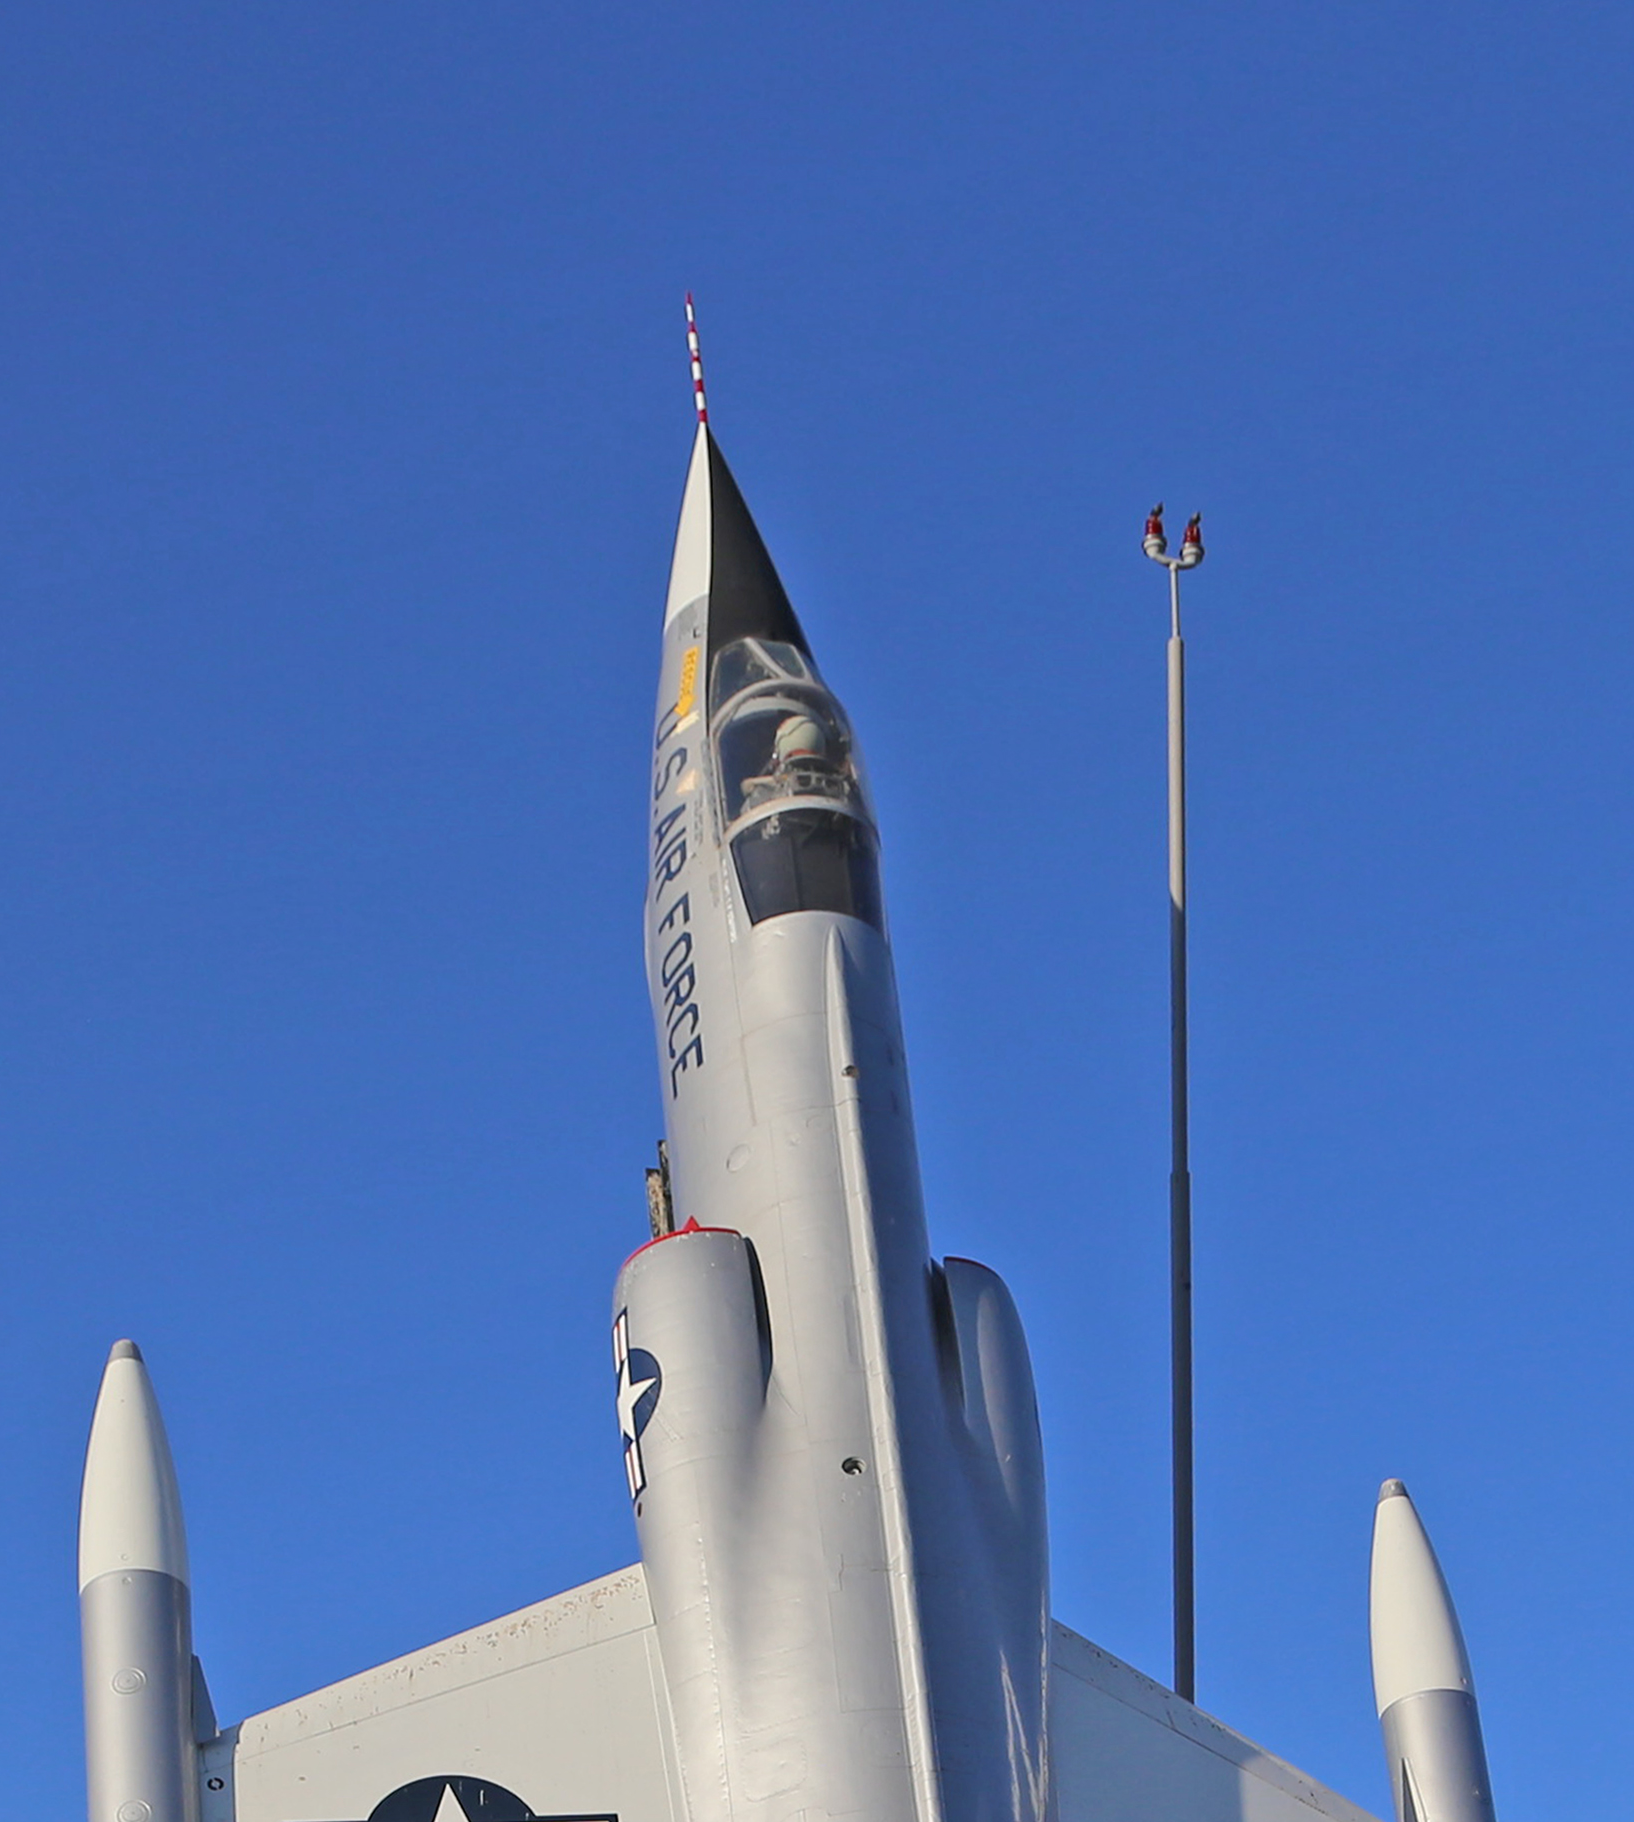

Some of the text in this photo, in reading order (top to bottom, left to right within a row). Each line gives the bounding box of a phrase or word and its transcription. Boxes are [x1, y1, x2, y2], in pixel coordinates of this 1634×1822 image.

[654, 702, 704, 1100] U.S. AIR FORCE
